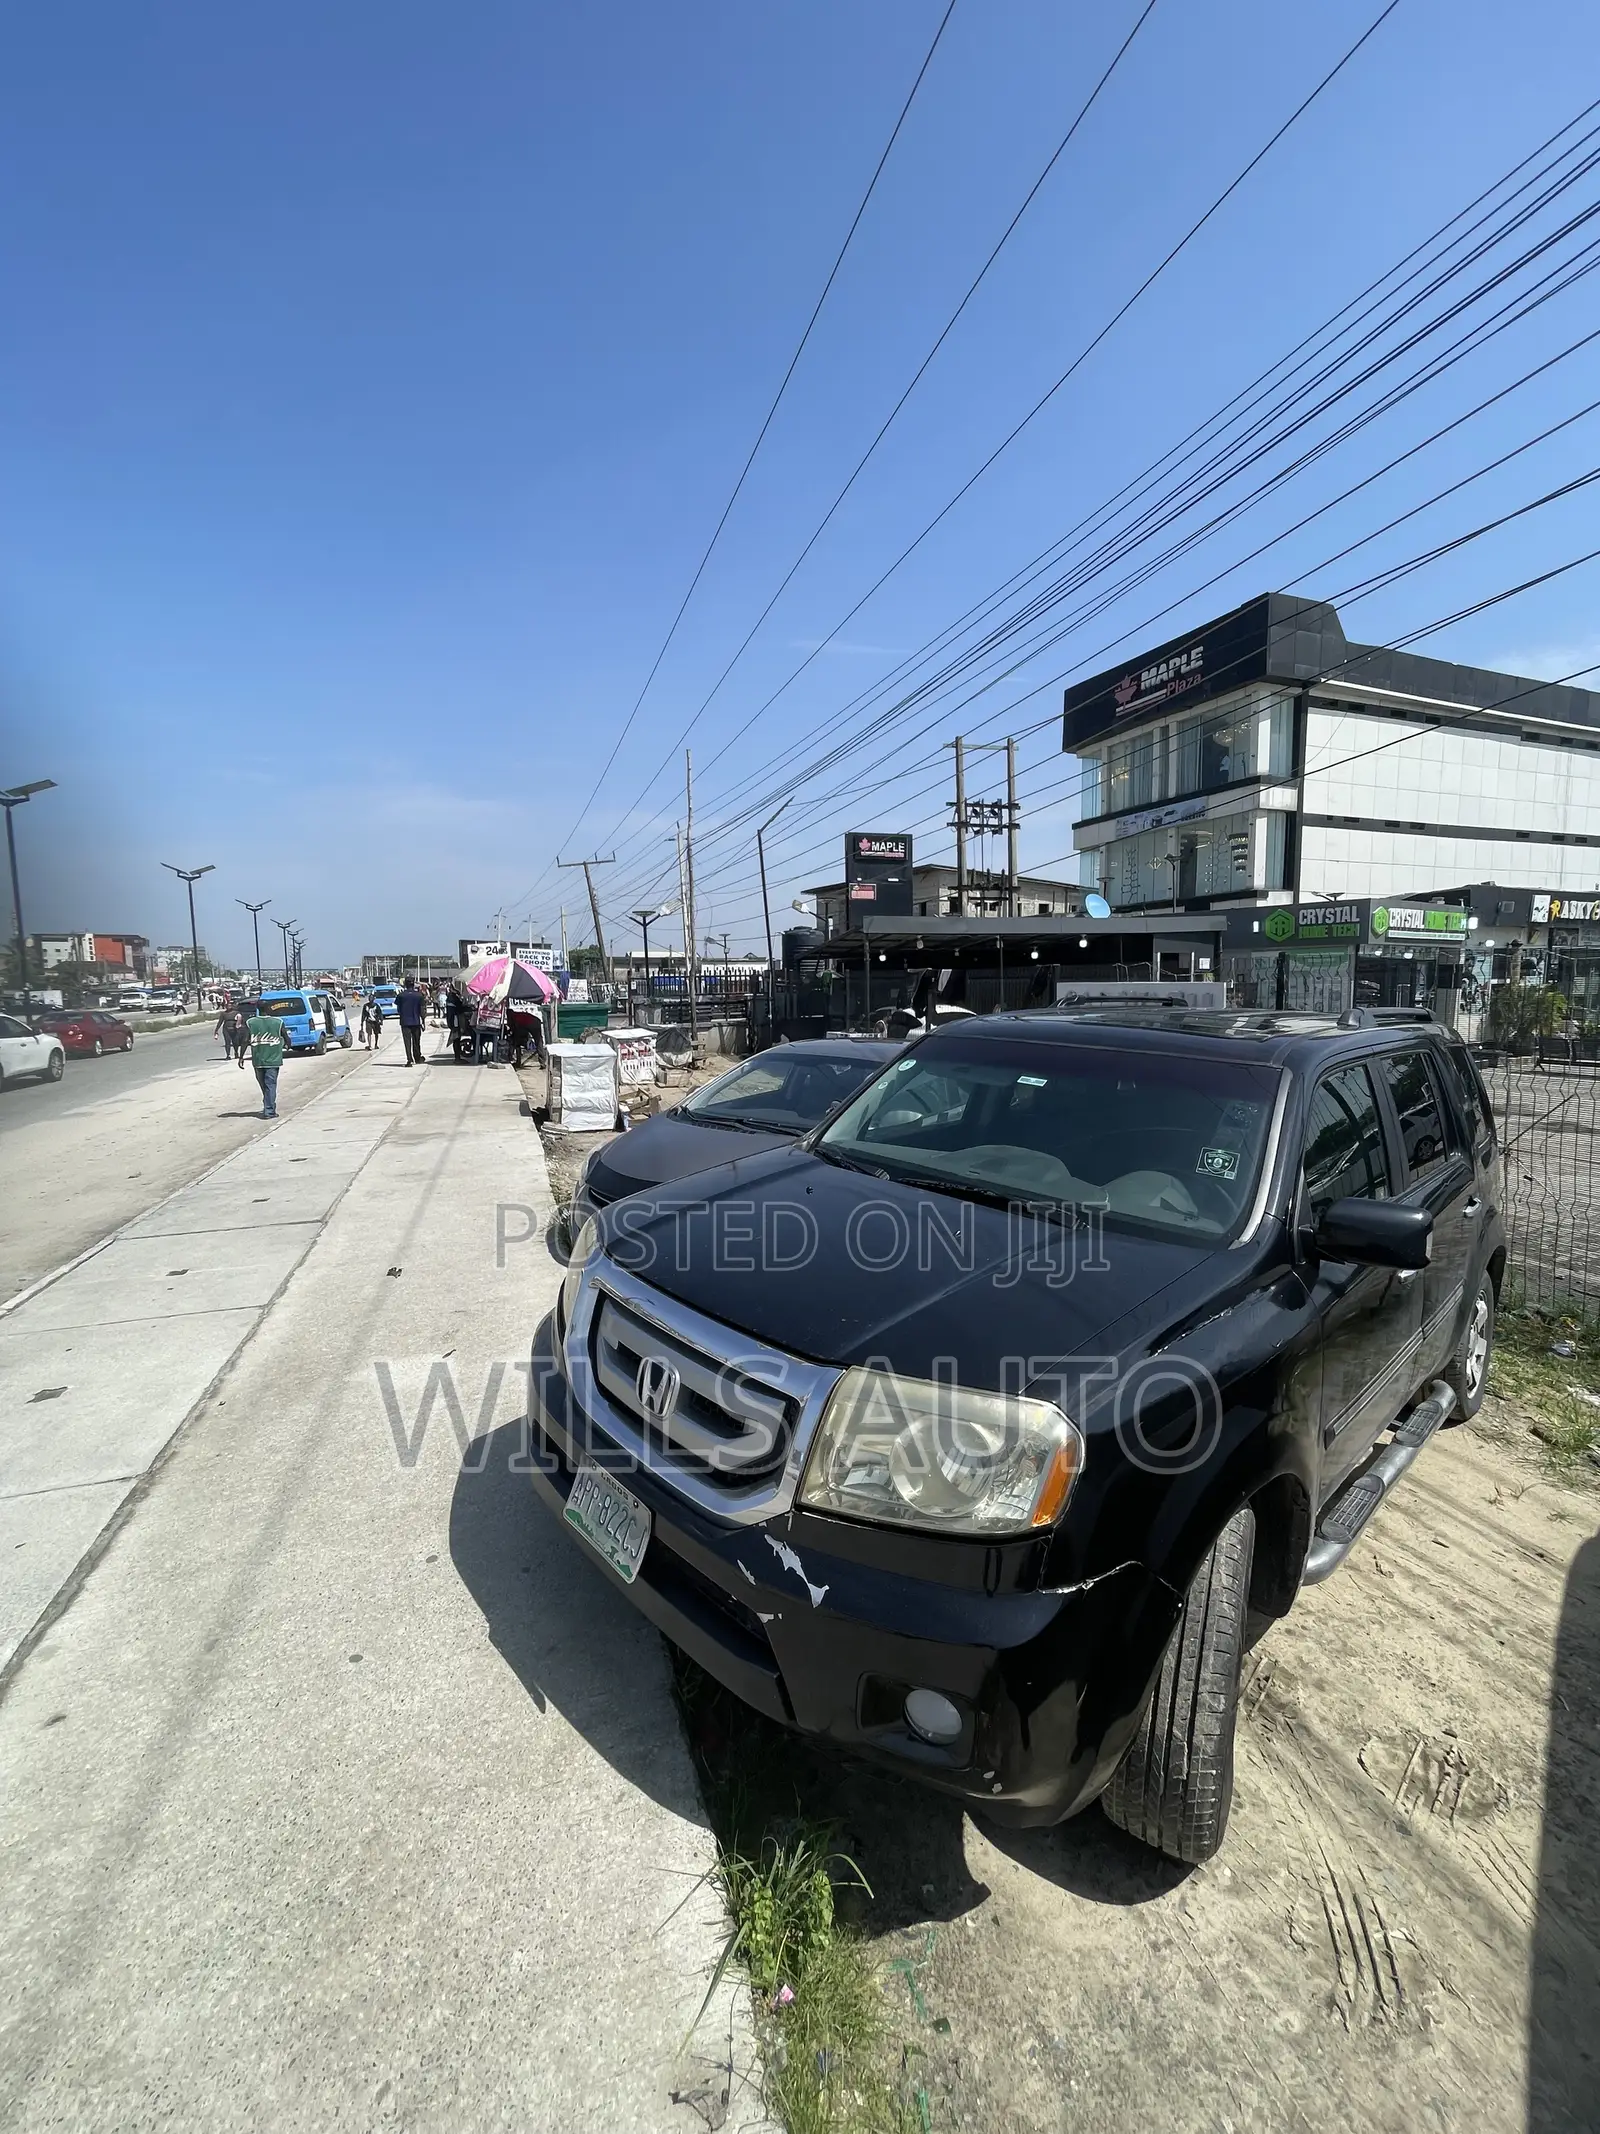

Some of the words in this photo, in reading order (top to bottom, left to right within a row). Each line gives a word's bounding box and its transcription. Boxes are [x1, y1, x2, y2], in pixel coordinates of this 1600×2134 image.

[1140, 646, 1204, 691] MAPLE
[1166, 674, 1202, 697] Plaza
[871, 841, 905, 852] MAPLE
[1298, 906, 1360, 925] CRYSTAL
[1388, 908, 1425, 929] CRYSTAL
[1299, 926, 1329, 939] HOME
[1332, 923, 1360, 937] TECH
[600, 1471, 630, 1501] LAGOS
